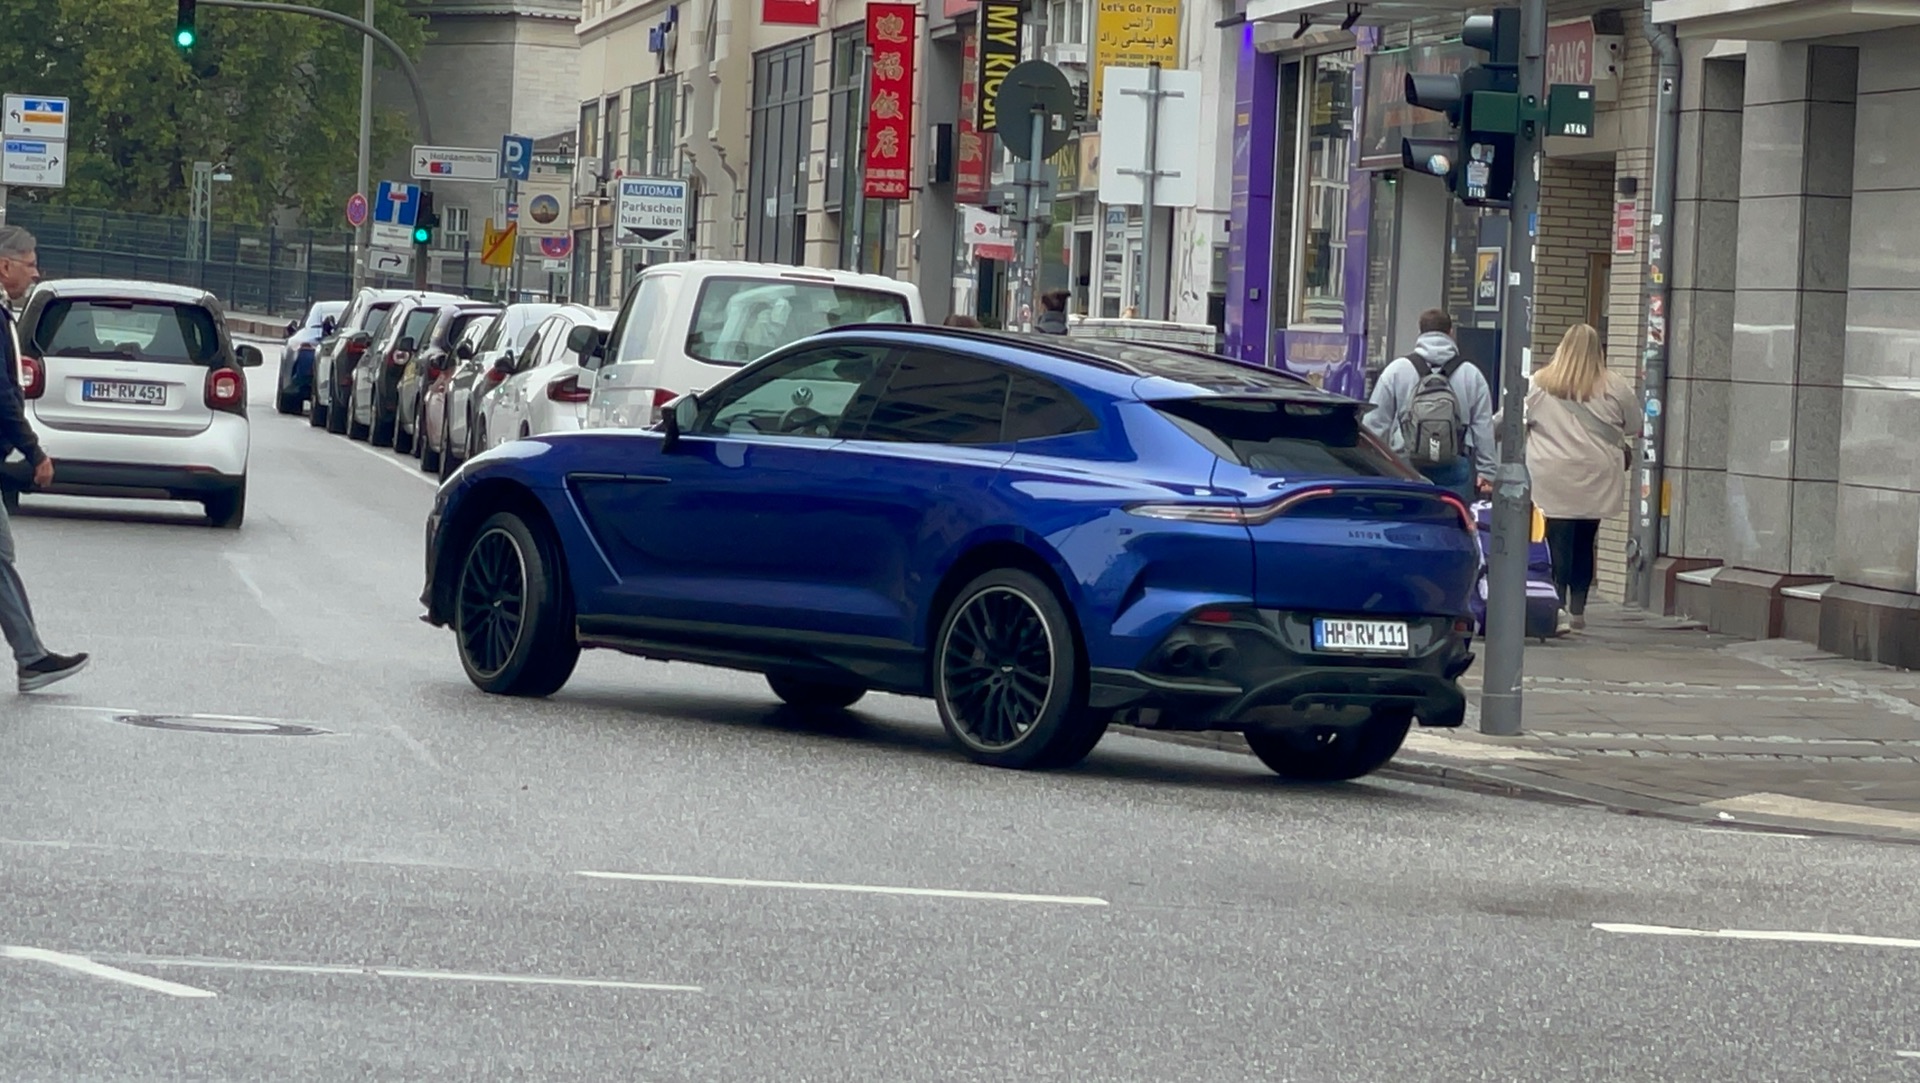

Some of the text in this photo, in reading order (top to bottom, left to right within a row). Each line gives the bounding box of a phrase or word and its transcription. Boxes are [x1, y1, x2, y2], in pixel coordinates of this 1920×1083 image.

[1101, 3, 1177, 14] Let's Go Travel
[986, 6, 1018, 46] MY
[506, 140, 523, 162] P
[626, 184, 680, 197] AUTOMAT
[622, 201, 683, 214] Parkschein
[621, 215, 683, 227] hier lösen
[92, 383, 164, 400] HH RW 451
[1324, 622, 1407, 647] HH RW 111
